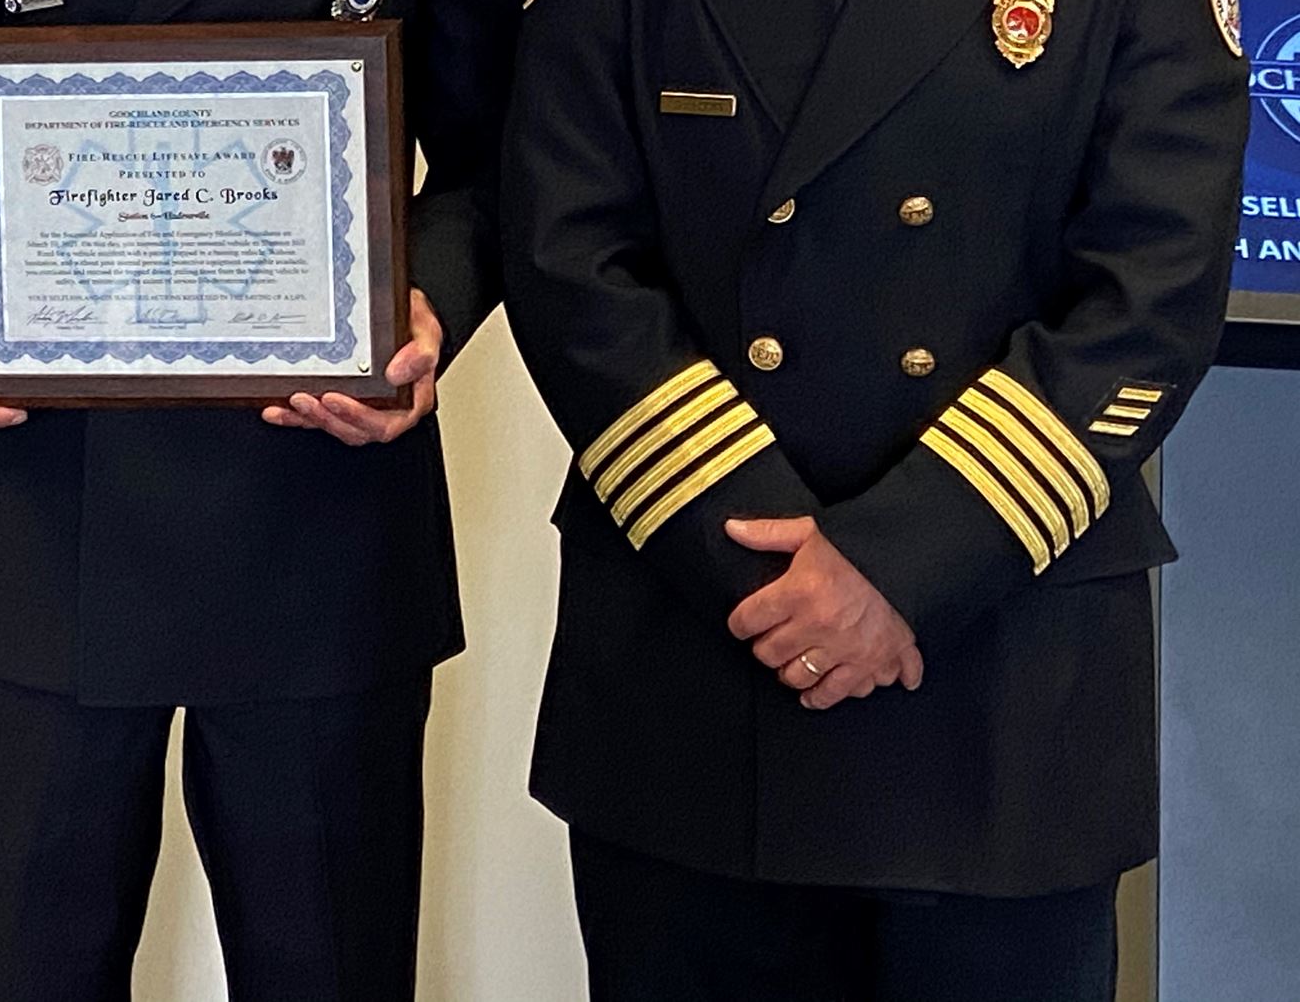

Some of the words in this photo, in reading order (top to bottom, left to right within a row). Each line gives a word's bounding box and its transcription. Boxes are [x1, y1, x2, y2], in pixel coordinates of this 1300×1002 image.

[172, 109, 212, 118] COUNTY
[25, 121, 88, 130] DEPARTMENT
[90, 121, 102, 129] OF
[170, 120, 188, 128] AND
[253, 118, 300, 127] SERVICES
[214, 151, 256, 160] AWARD
[119, 170, 186, 179] PRESENTED
[192, 170, 206, 179] TO
[48, 188, 138, 208] Firefighter
[143, 188, 191, 207] Jared
[195, 187, 214, 204] C.
[219, 187, 279, 204] Brooks
